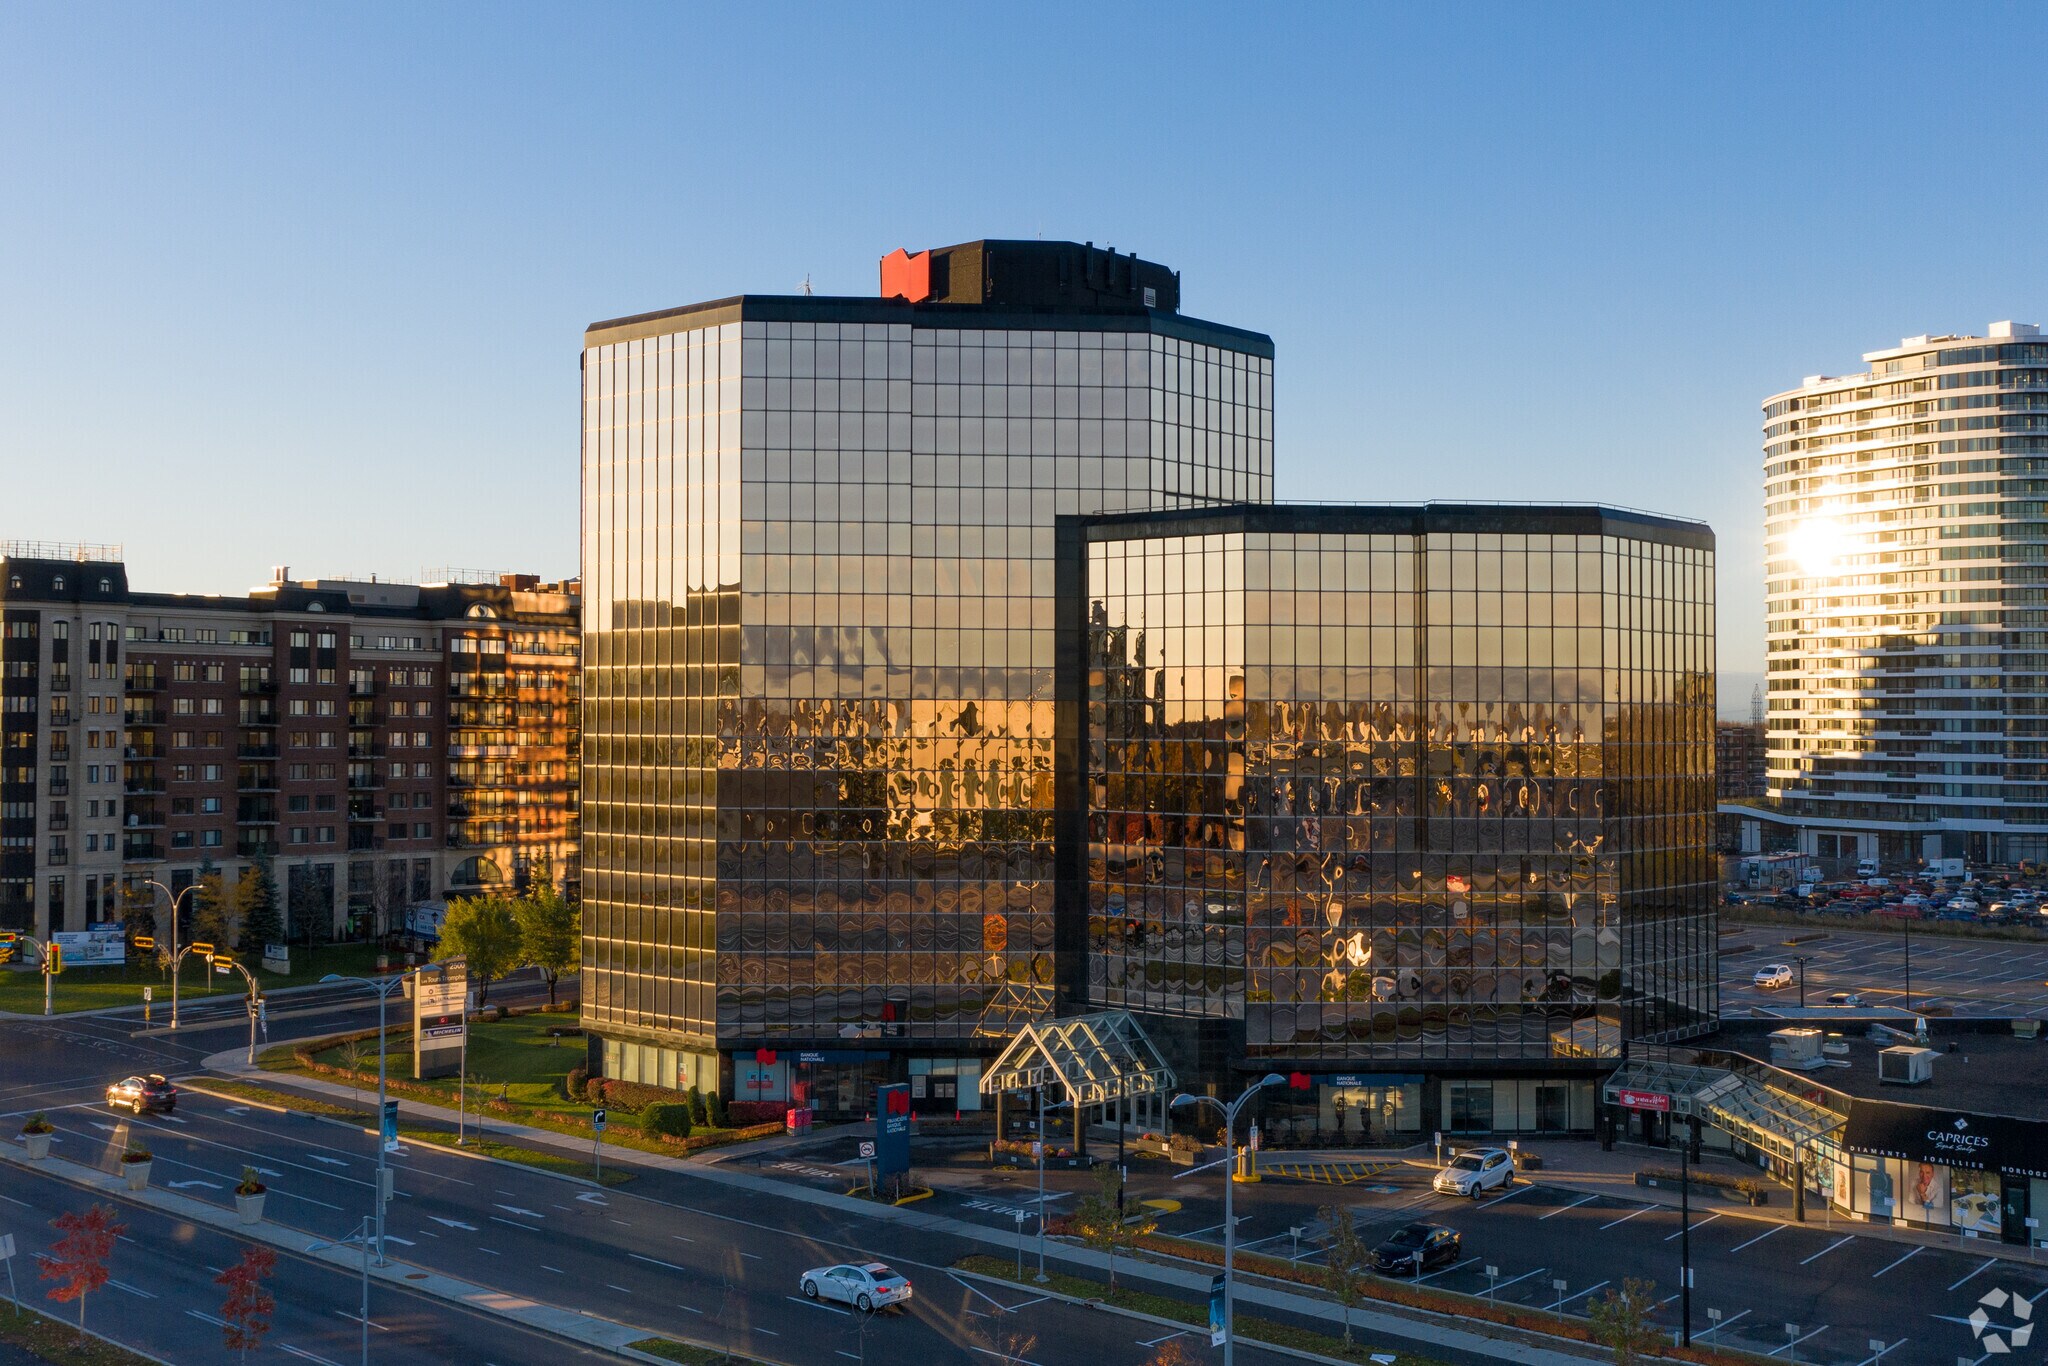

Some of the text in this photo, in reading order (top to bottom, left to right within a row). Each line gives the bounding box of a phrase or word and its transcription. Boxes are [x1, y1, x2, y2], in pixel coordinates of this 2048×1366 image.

[449, 962, 466, 970] 2500
[432, 1028, 462, 1036] MICHELIN
[886, 1121, 902, 1129] BANQUE
[886, 1126, 906, 1134] NATIONALE
[1927, 1130, 1989, 1147] CAPRICES
[1849, 1145, 2047, 1178] DIAMANTS JOAILLIER HORLOGE
